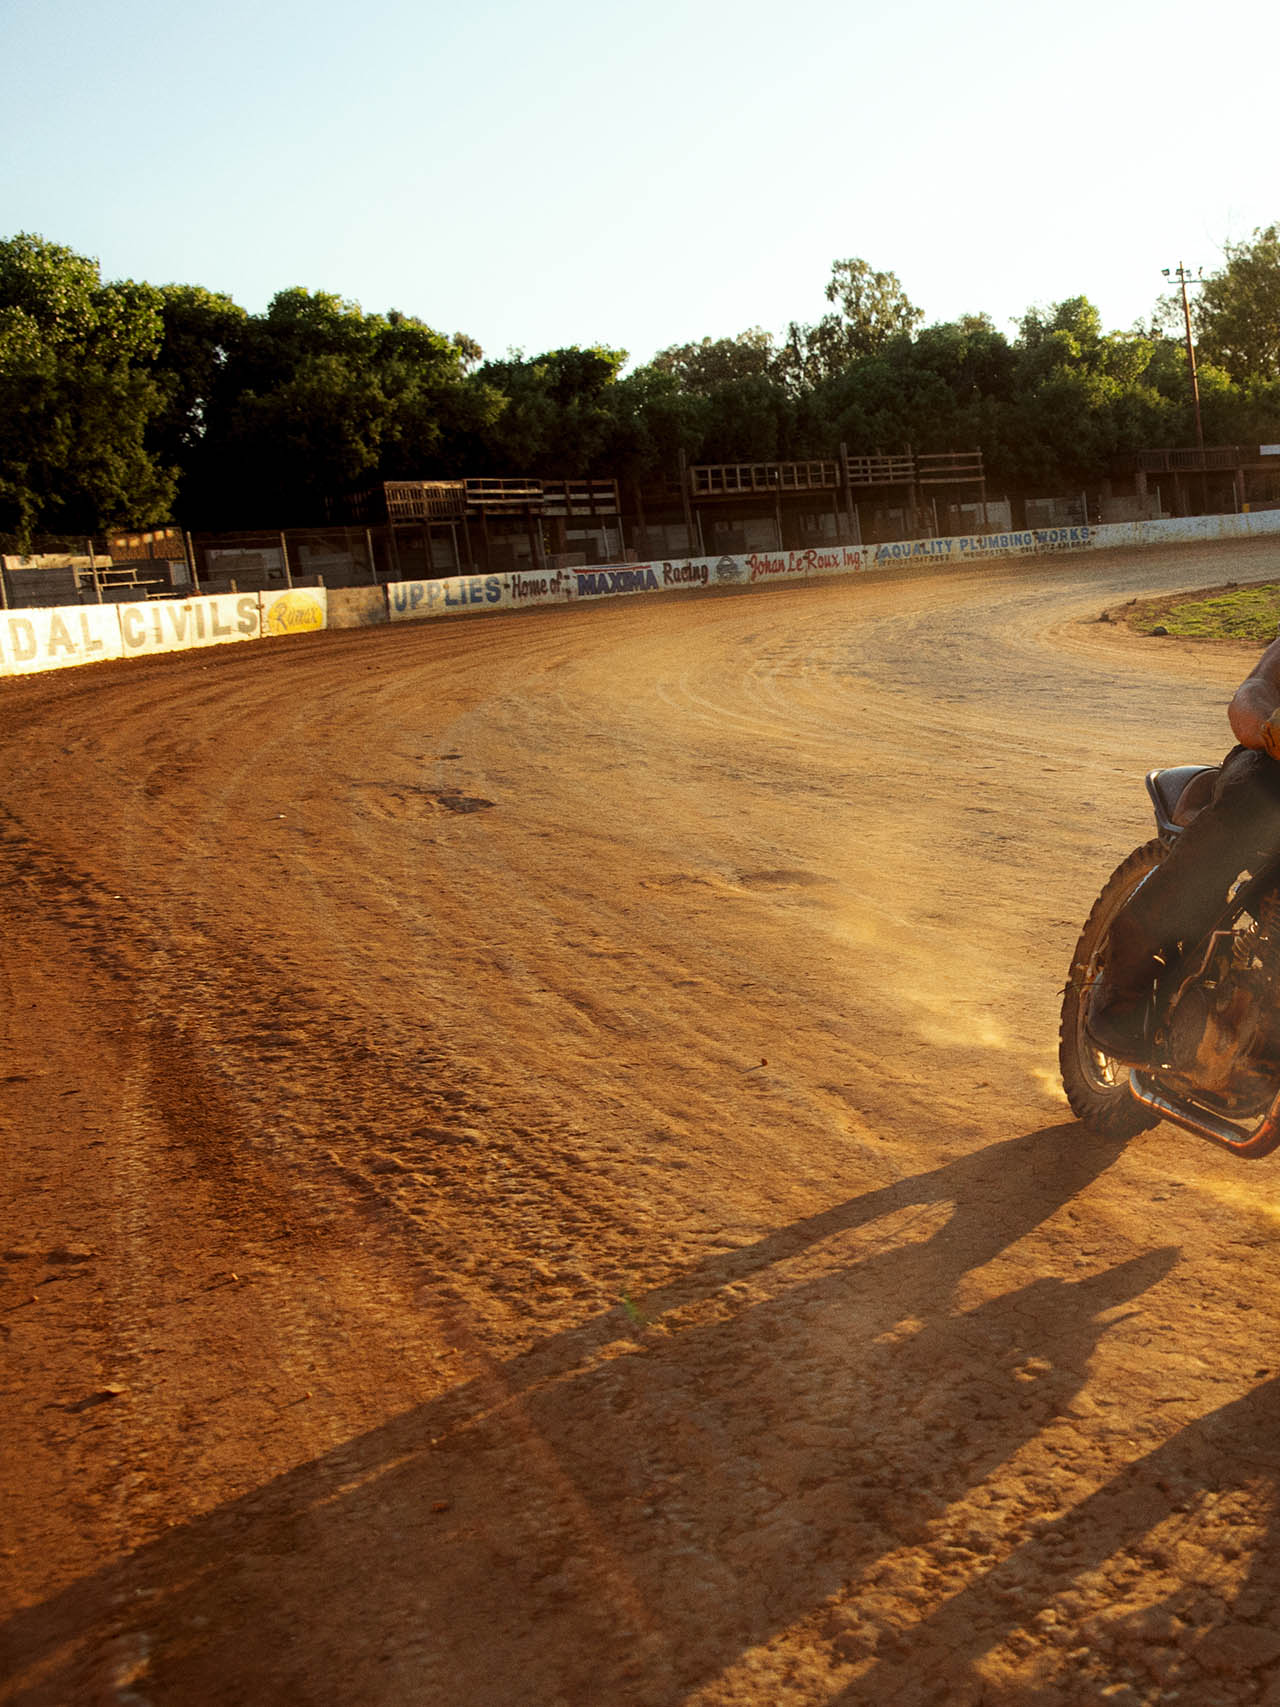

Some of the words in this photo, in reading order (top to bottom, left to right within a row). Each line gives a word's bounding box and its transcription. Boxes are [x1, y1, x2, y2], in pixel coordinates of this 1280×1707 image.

[959, 533, 1033, 552] PLUMBING
[1036, 527, 1090, 544] WORKS
[511, 574, 549, 599] Home
[577, 569, 660, 597] MAXIMA
[662, 561, 709, 585] Racing
[748, 554, 786, 582] Johan
[806, 548, 840, 571] Roux
[393, 575, 502, 612] UPPLIES
[0, 612, 103, 664] DAL
[123, 597, 259, 648] CIVILS
